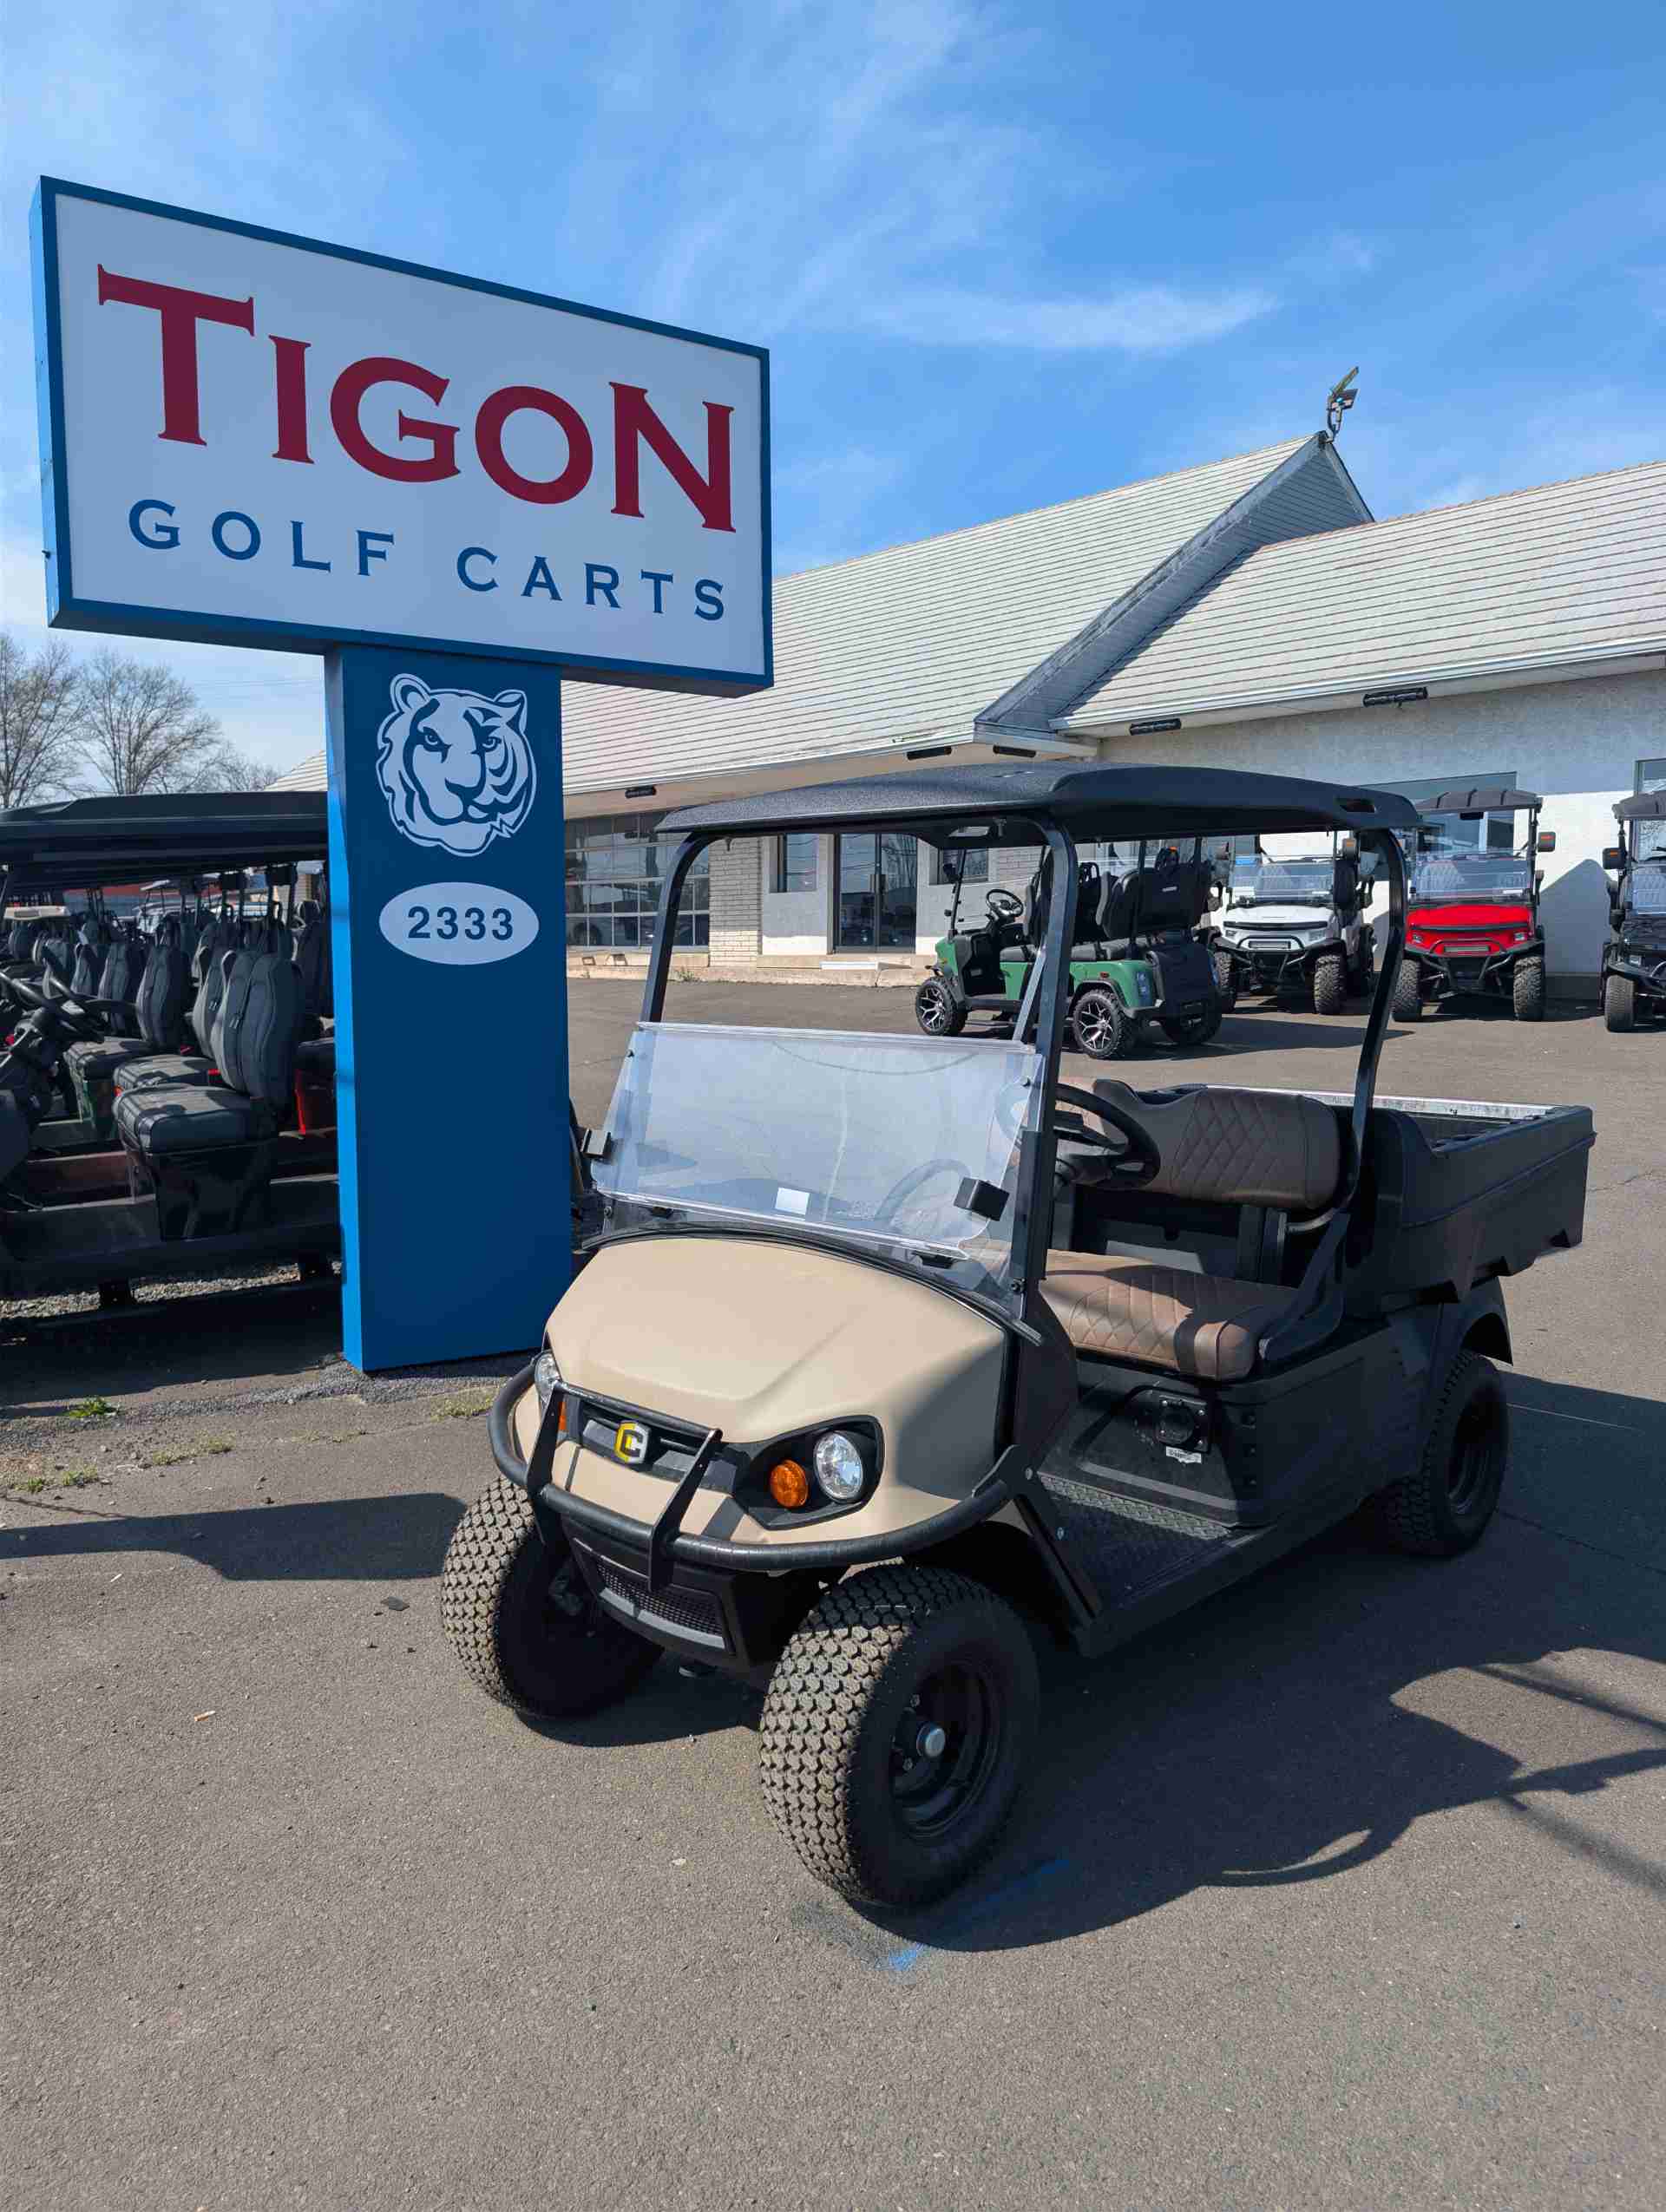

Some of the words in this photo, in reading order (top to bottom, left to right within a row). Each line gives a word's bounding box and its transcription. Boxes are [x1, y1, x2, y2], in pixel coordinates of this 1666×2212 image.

[97, 264, 735, 532] TIGON
[128, 499, 395, 577] GOLF
[456, 546, 725, 621] CARTS
[408, 906, 514, 941] 2333
